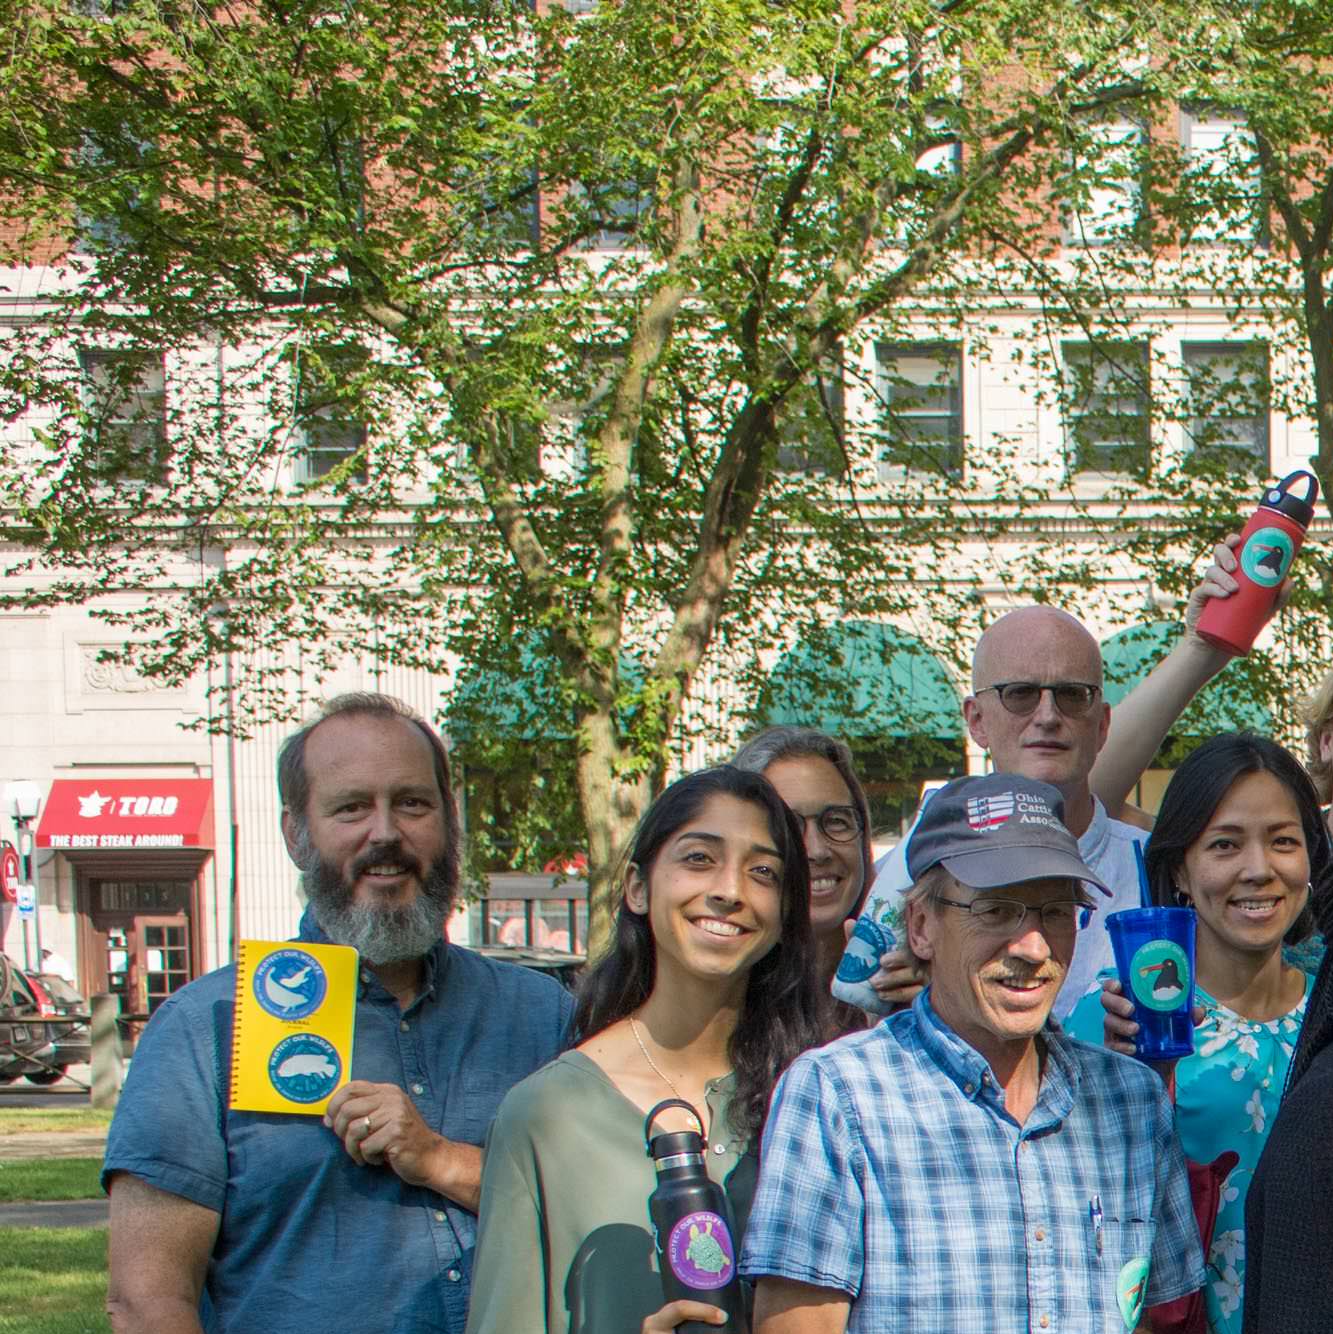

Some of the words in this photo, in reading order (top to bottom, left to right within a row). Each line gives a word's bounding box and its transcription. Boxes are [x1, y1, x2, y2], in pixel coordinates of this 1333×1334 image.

[119, 796, 179, 816] TORO
[1016, 793, 1045, 804] Ohio
[50, 834, 71, 847] THE
[72, 834, 99, 847] BEST
[100, 834, 133, 847] STEAK
[134, 834, 183, 847] AROUND!
[271, 1039, 291, 1066] PROTECT
